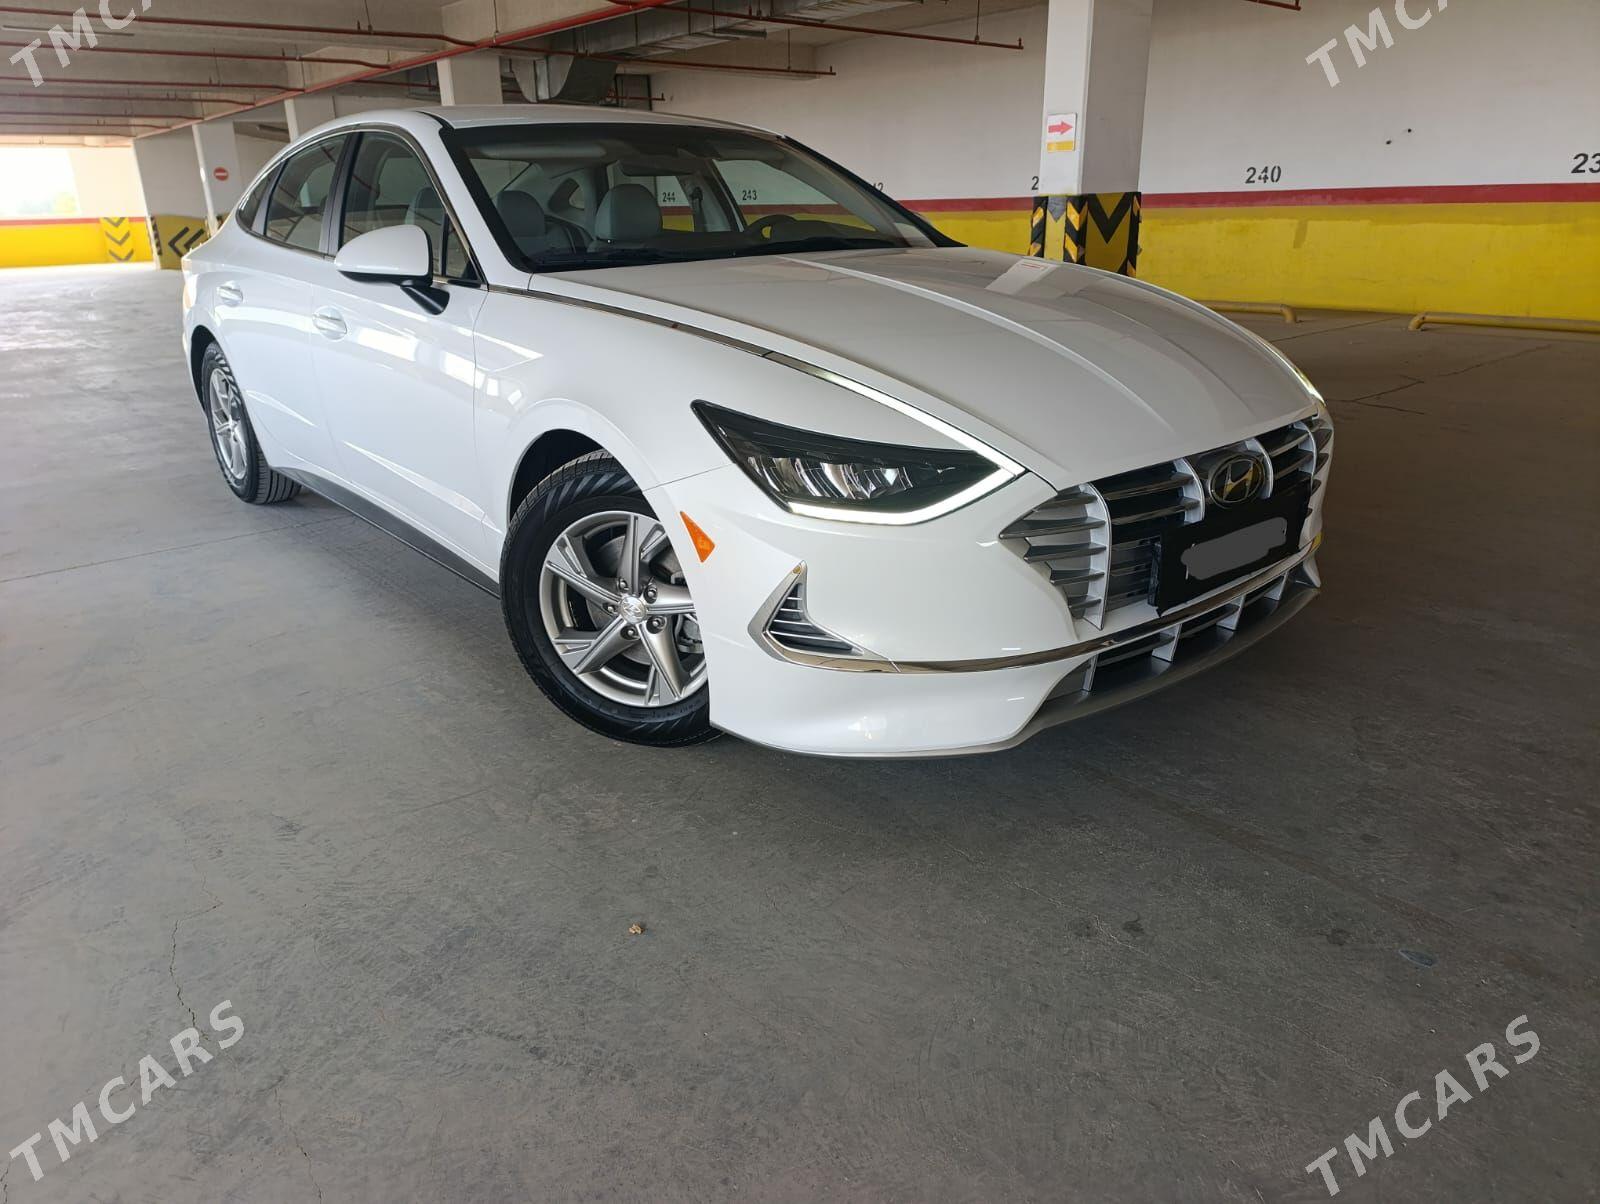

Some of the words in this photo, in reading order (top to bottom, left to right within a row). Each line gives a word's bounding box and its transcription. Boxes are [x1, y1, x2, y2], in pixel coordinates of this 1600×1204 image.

[1570, 152, 1600, 174] 23
[1244, 165, 1282, 184] 240
[662, 191, 676, 203] 244
[742, 189, 758, 201] 243
